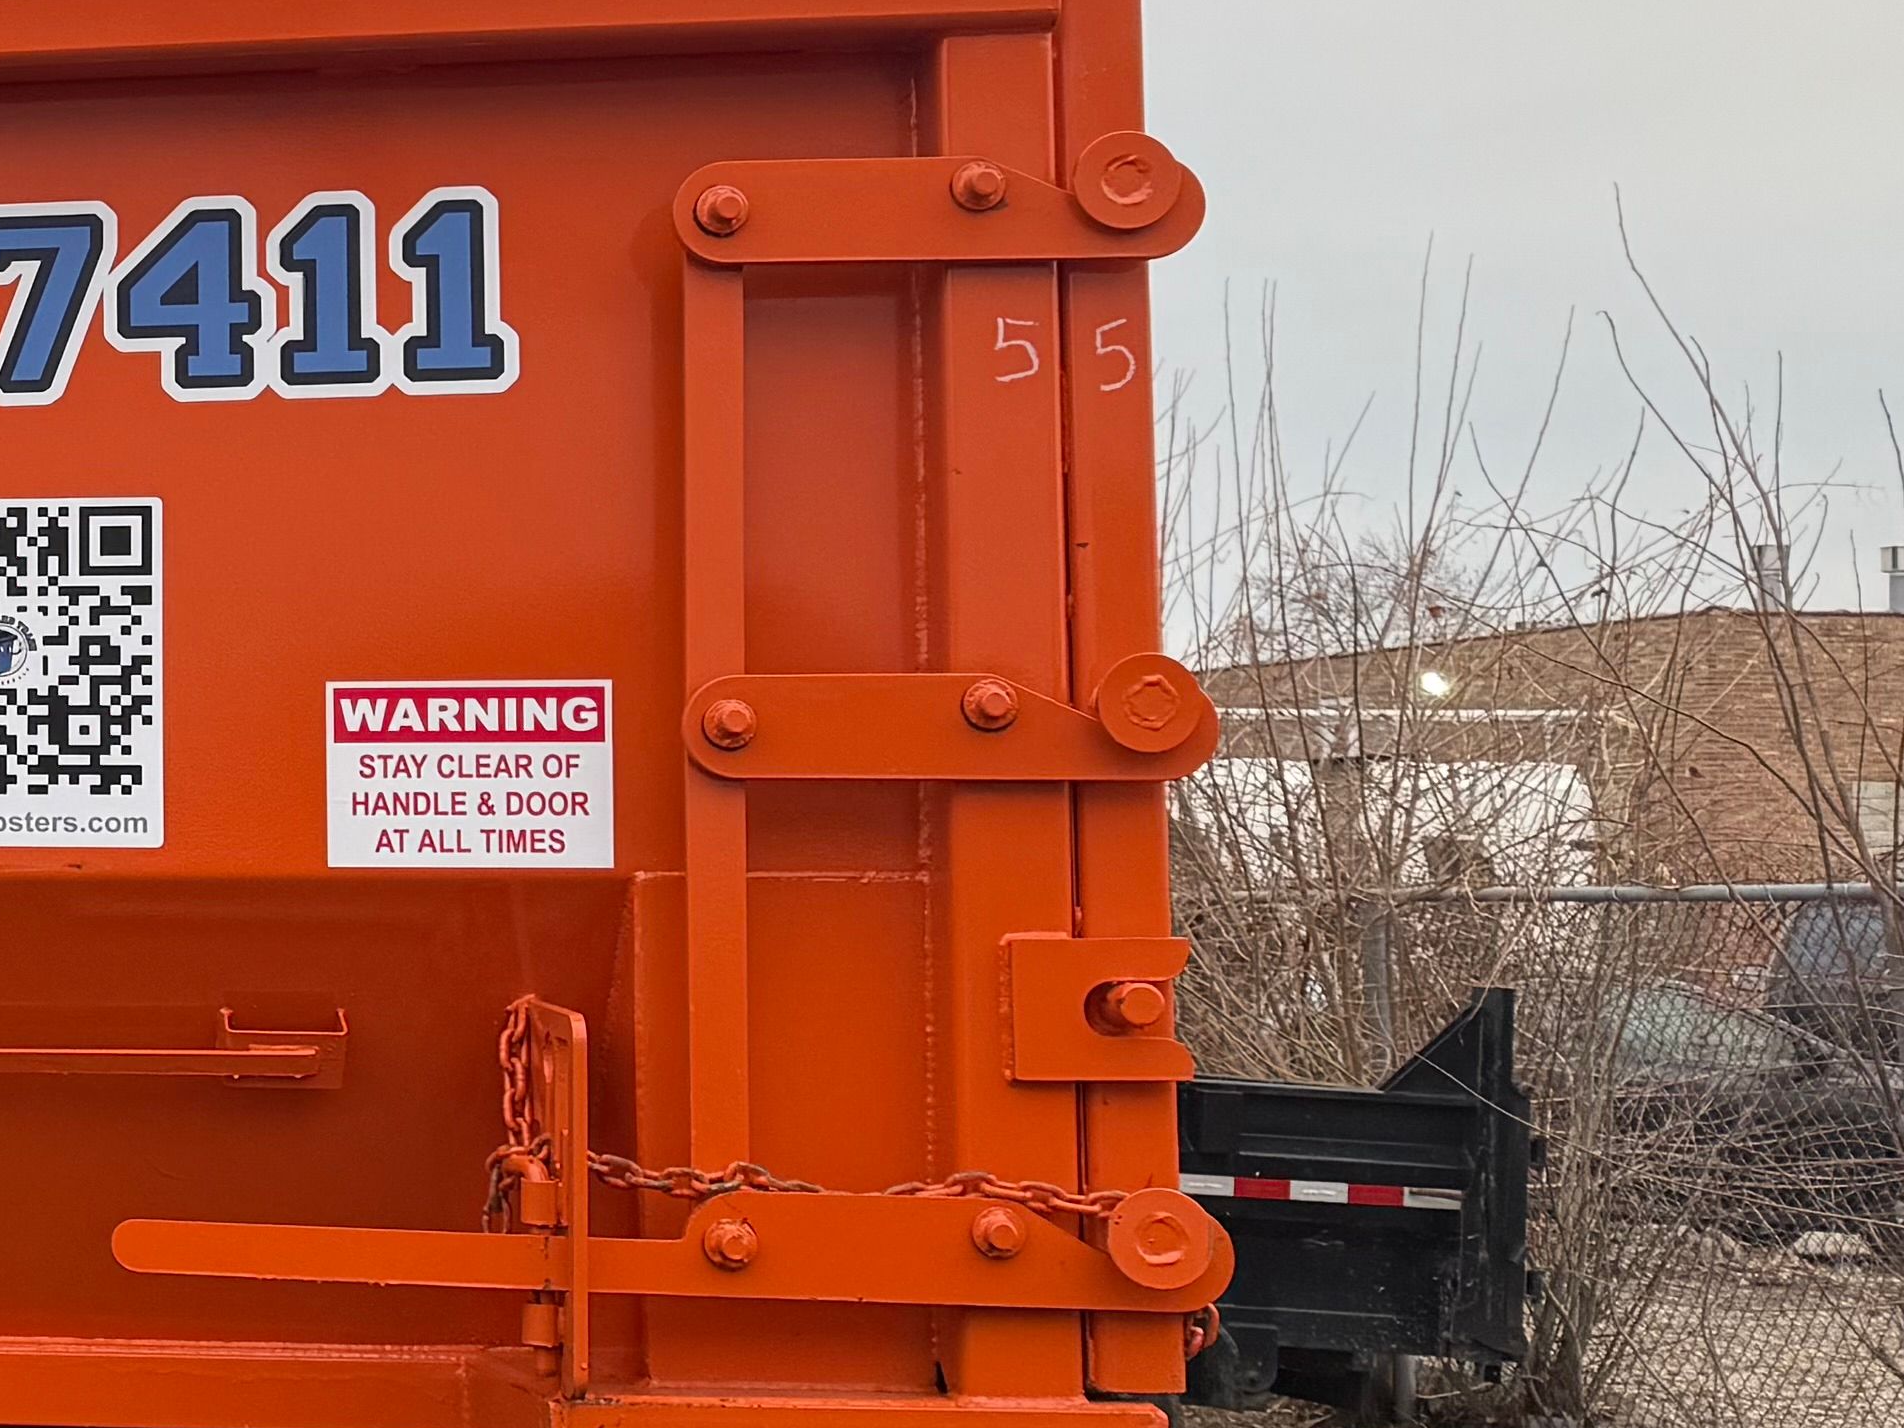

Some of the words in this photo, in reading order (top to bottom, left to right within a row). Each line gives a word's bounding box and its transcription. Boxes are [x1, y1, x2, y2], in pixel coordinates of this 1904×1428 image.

[993, 316, 1041, 383] 5
[1094, 318, 1137, 392] 5
[339, 697, 599, 733] WARNING
[359, 754, 428, 779] STAY
[436, 754, 534, 779] CLEAR
[542, 754, 581, 779] OF
[352, 791, 468, 816] HANDLE
[477, 791, 496, 816] &
[506, 791, 590, 816] DOOR
[375, 829, 409, 853] AT
[418, 829, 471, 853] ALL
[480, 829, 566, 853] TIMES
